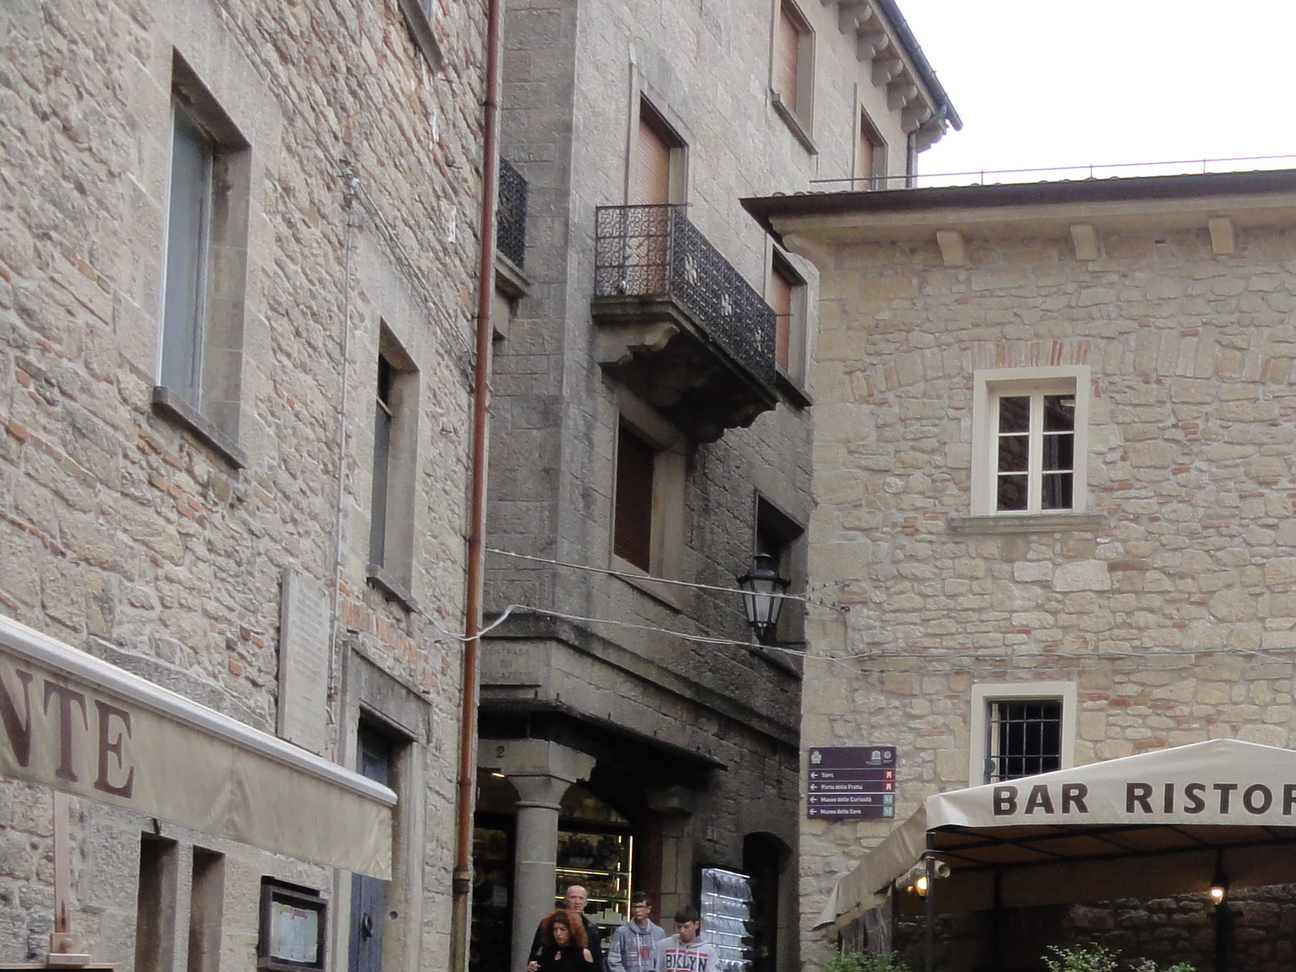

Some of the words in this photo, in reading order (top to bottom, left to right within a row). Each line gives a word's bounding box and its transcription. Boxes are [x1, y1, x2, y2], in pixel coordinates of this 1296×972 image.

[495, 745, 505, 759] 2
[993, 783, 1090, 816] BAR
[666, 954, 708, 972] BKLYN
